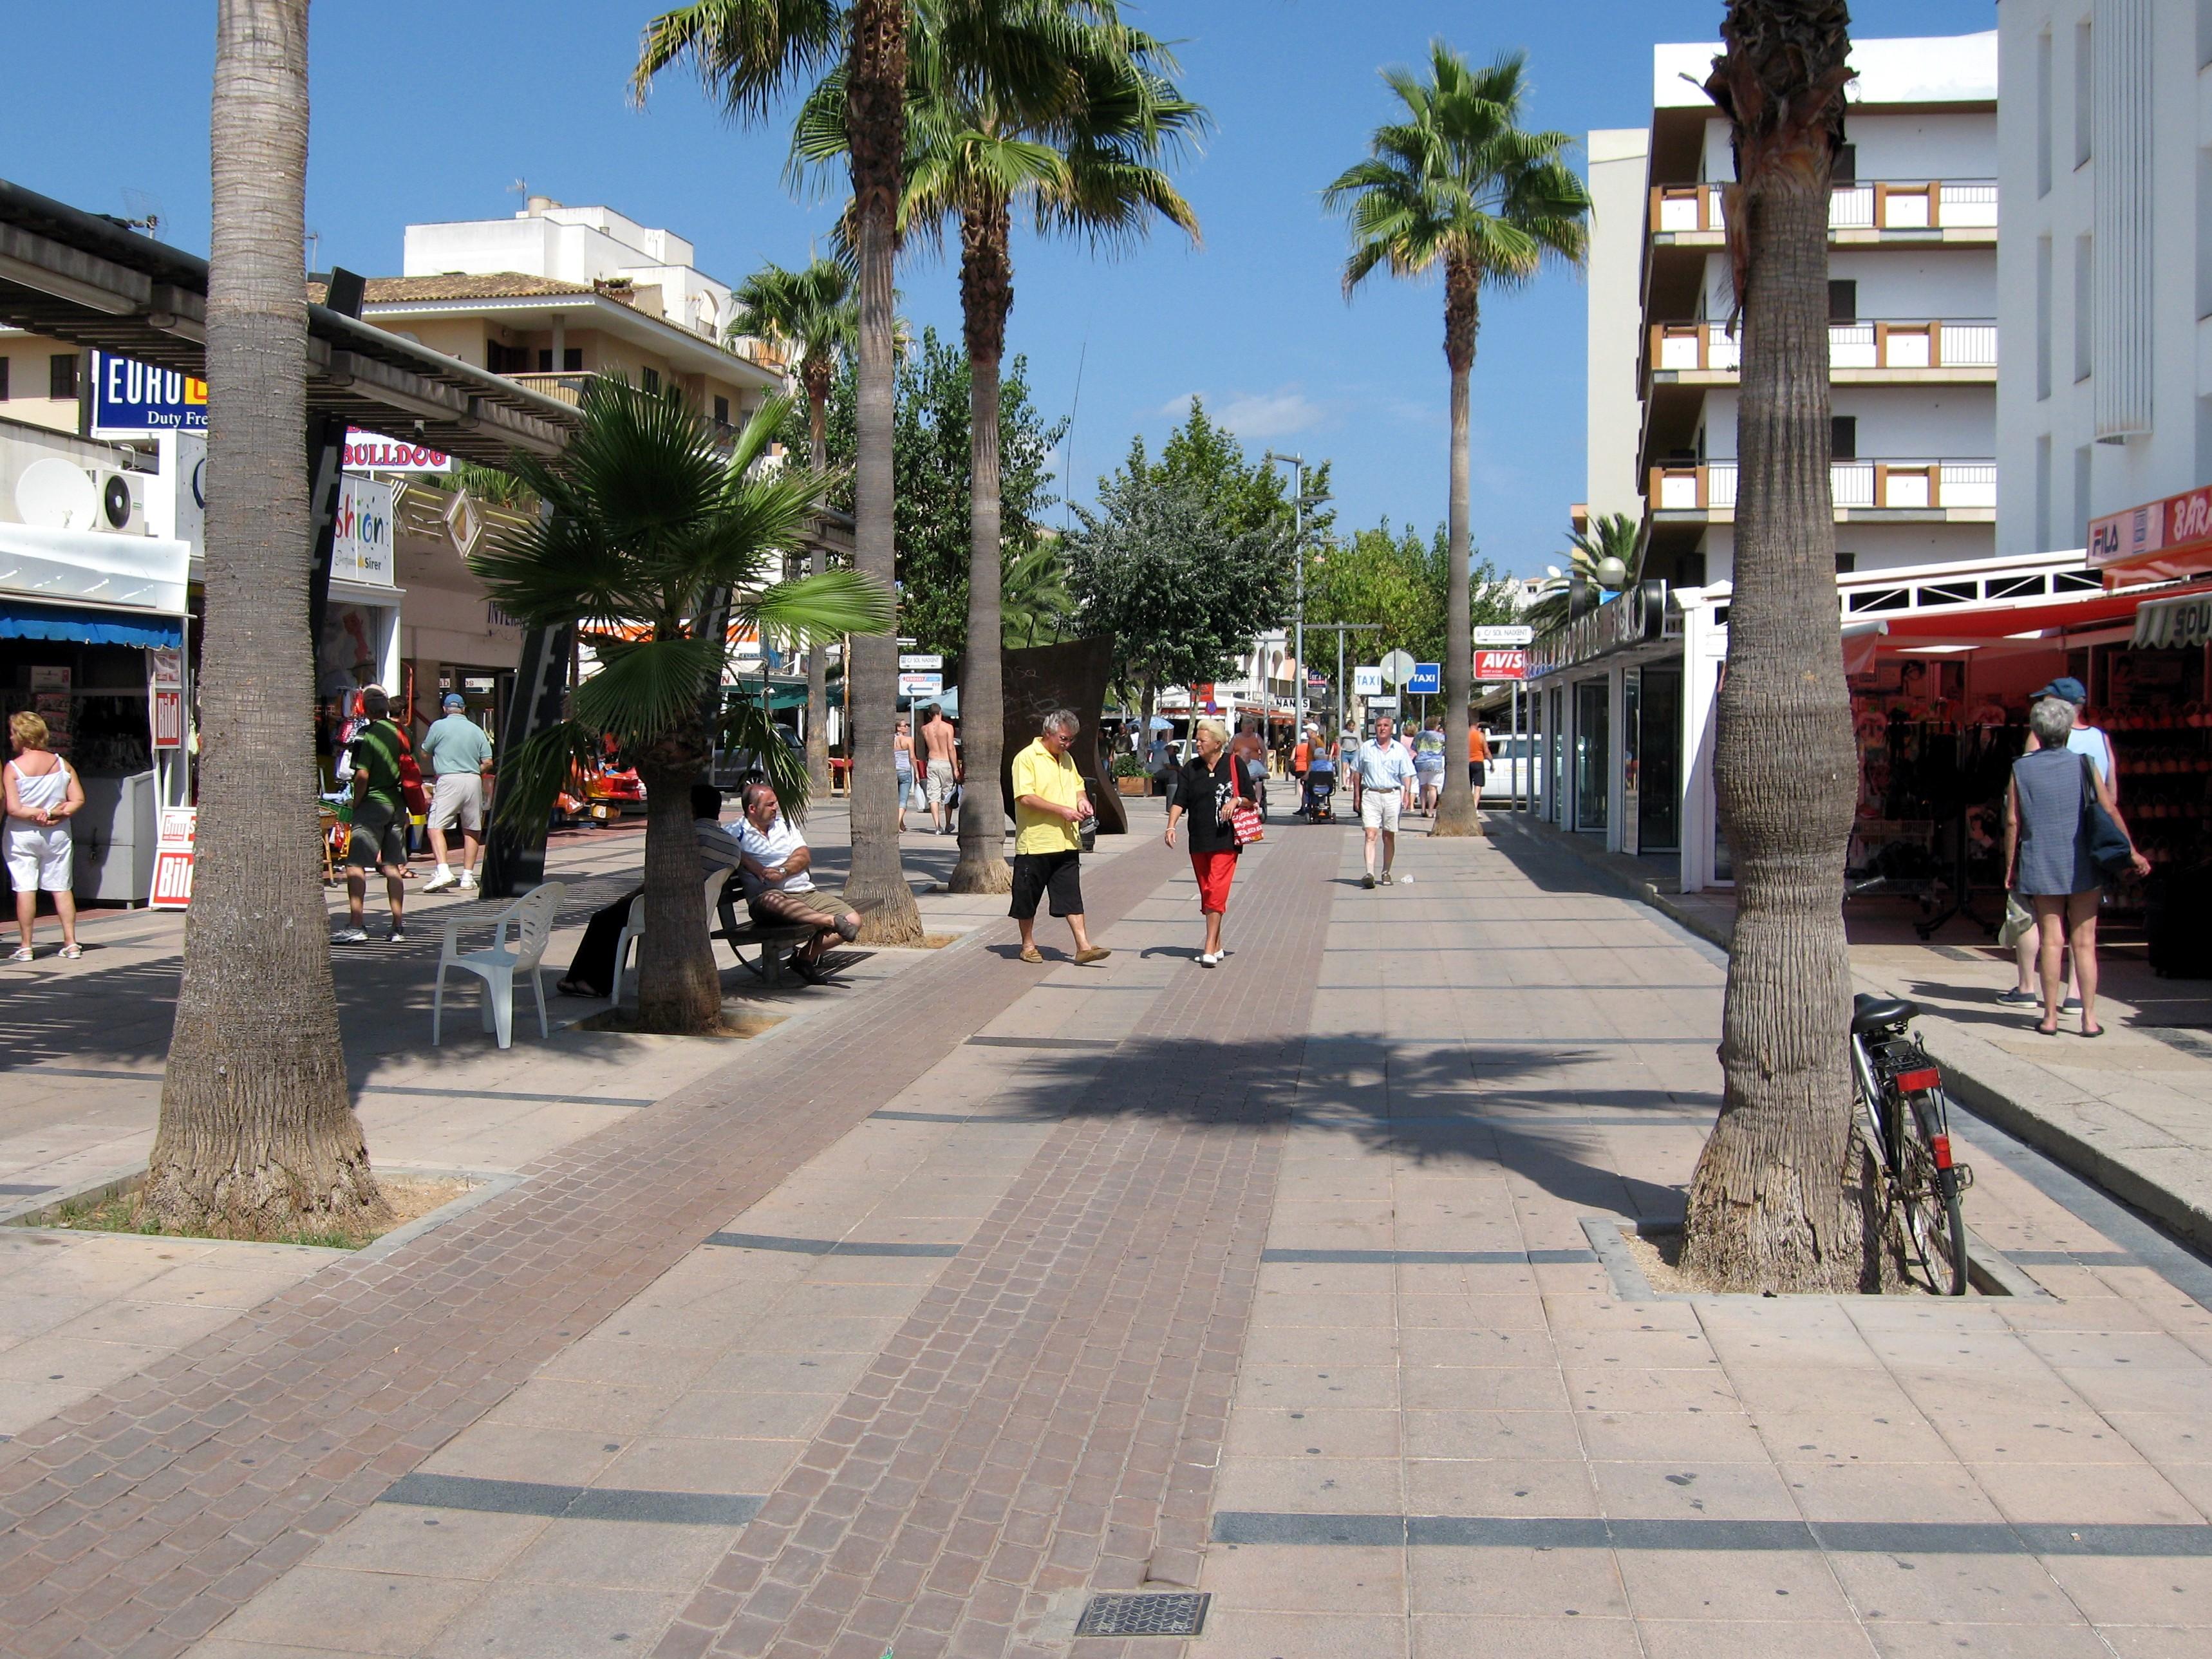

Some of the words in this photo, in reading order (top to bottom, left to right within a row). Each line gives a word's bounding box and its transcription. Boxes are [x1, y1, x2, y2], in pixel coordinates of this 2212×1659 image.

[147, 411, 182, 427] Duty
[342, 443, 446, 467] BULLDOG
[2093, 523, 2119, 556] FILA
[364, 557, 382, 570] Sirer
[1481, 653, 1523, 669] AVIS
[1356, 675, 1380, 686] TAXI
[1413, 673, 1436, 682] TAXI
[158, 693, 178, 738] Bild
